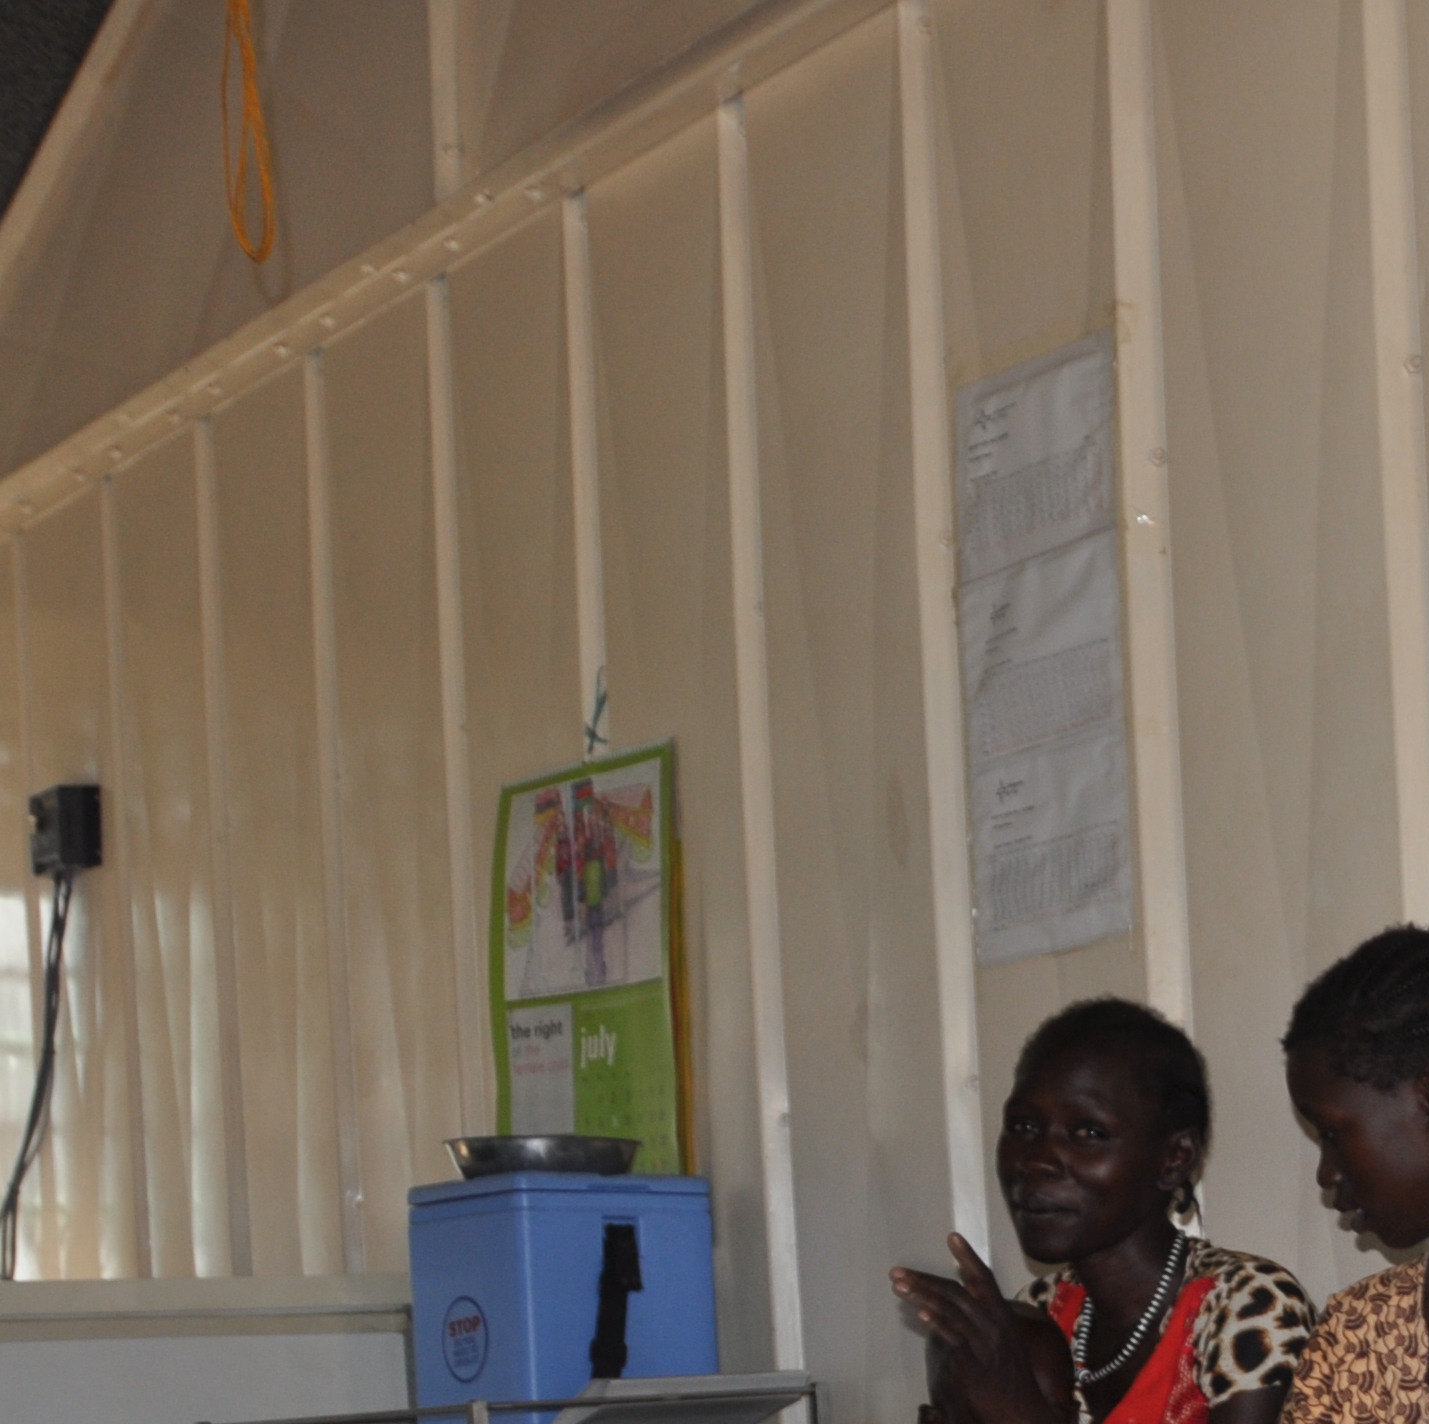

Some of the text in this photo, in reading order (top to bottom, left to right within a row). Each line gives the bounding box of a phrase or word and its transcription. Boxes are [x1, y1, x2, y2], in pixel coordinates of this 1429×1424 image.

[510, 1020, 563, 1040] the right
[581, 1024, 617, 1069] july
[449, 1315, 480, 1337] STOP
